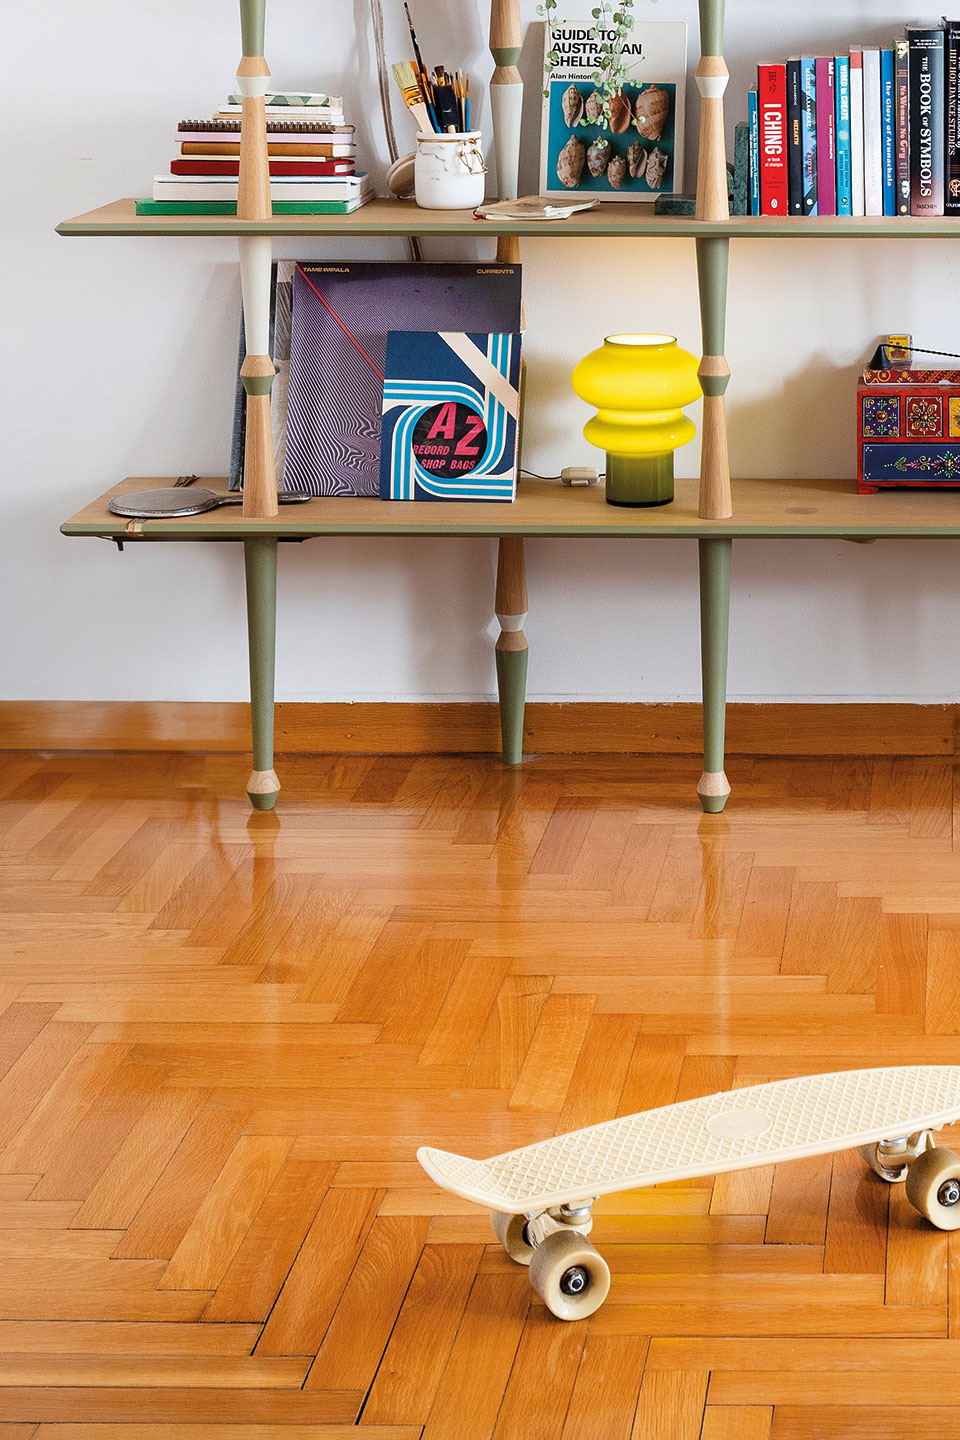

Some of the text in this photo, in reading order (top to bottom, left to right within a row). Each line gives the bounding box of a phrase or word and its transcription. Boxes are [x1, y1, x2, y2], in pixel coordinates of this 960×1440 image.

[598, 29, 617, 42] TO
[840, 64, 849, 87] WIRED
[921, 56, 929, 72] THE
[919, 73, 932, 116] BOOK
[949, 49, 957, 156] HIP HOP DANCE STUDIES
[840, 95, 849, 121] CREATE
[884, 98, 892, 123] Glory
[764, 112, 783, 155] CHING
[886, 124, 892, 136] of
[898, 85, 909, 159] No Woman No Cry
[919, 128, 932, 198] SYMBOLS
[426, 402, 457, 439] A
[413, 444, 450, 456] RECORD
[421, 458, 475, 470] SHOP BAGS
